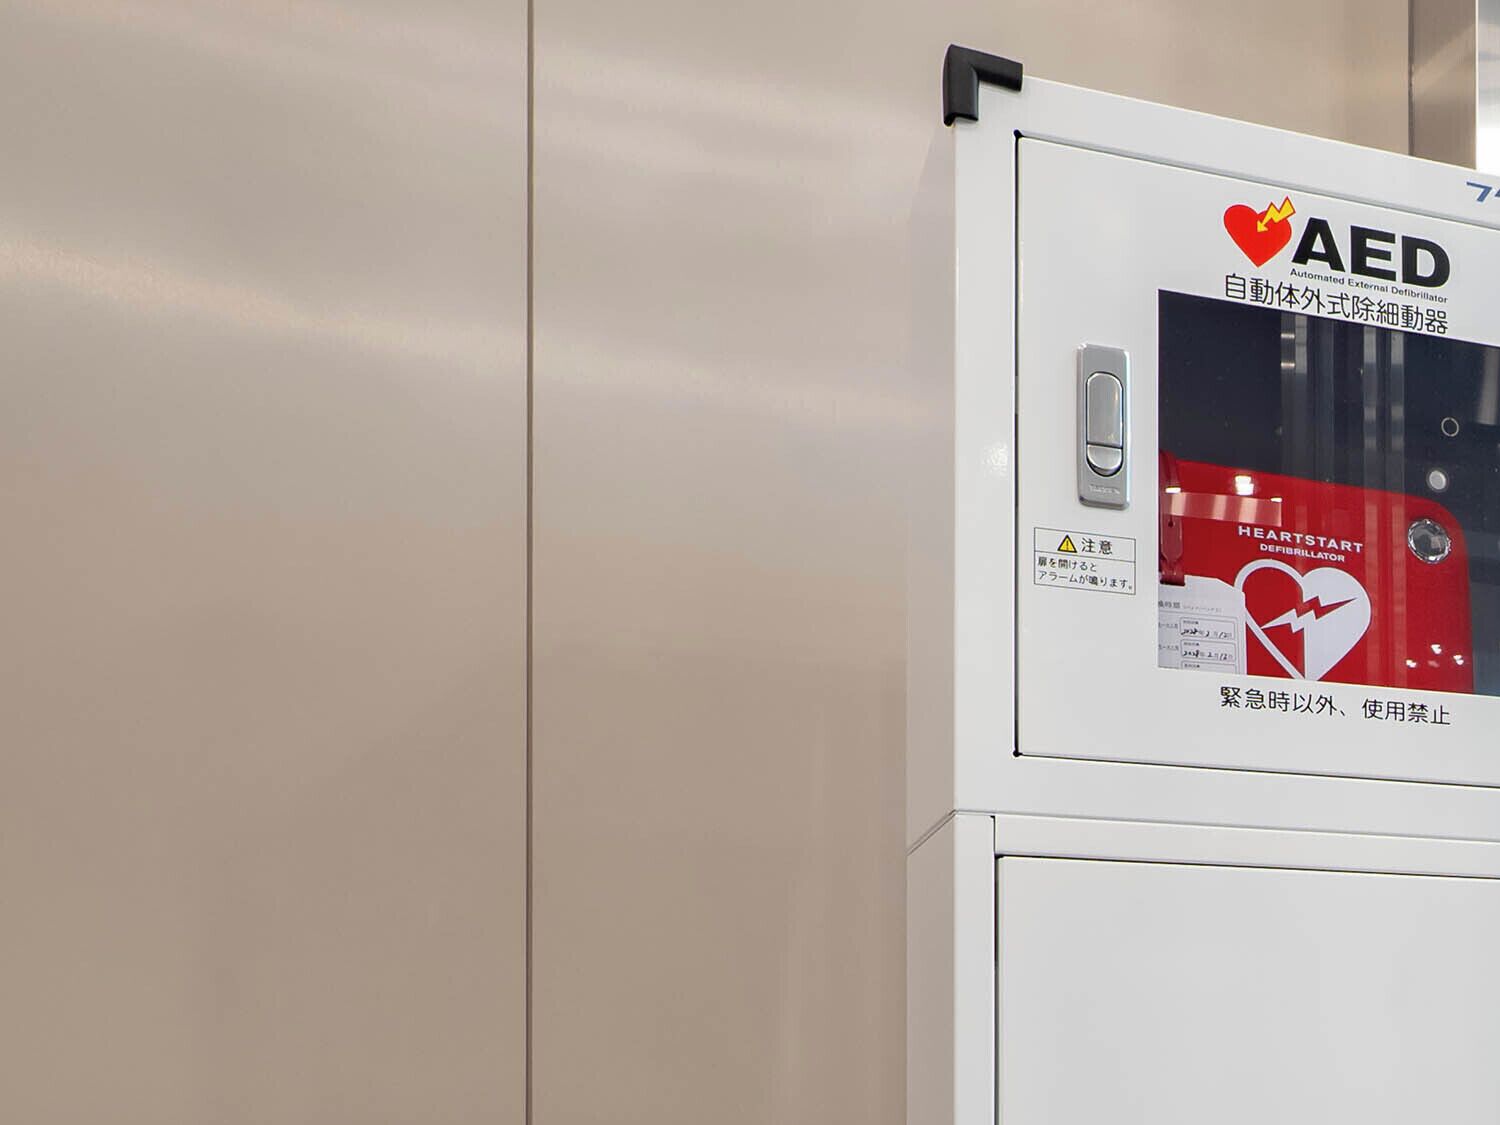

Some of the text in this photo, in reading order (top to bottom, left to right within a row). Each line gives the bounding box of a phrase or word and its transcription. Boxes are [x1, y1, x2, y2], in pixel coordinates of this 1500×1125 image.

[1291, 216, 1451, 288] AED
[1225, 273, 1448, 335] 自動体外式除細動器
[1290, 267, 1449, 304] Automated External Defibrillator
[1081, 537, 1113, 555] 注意
[1238, 525, 1364, 553] HEARTSTART
[1259, 543, 1345, 562] DEFIBRILLATOR
[1219, 685, 1452, 726] 緊急時以外、使用禁止
